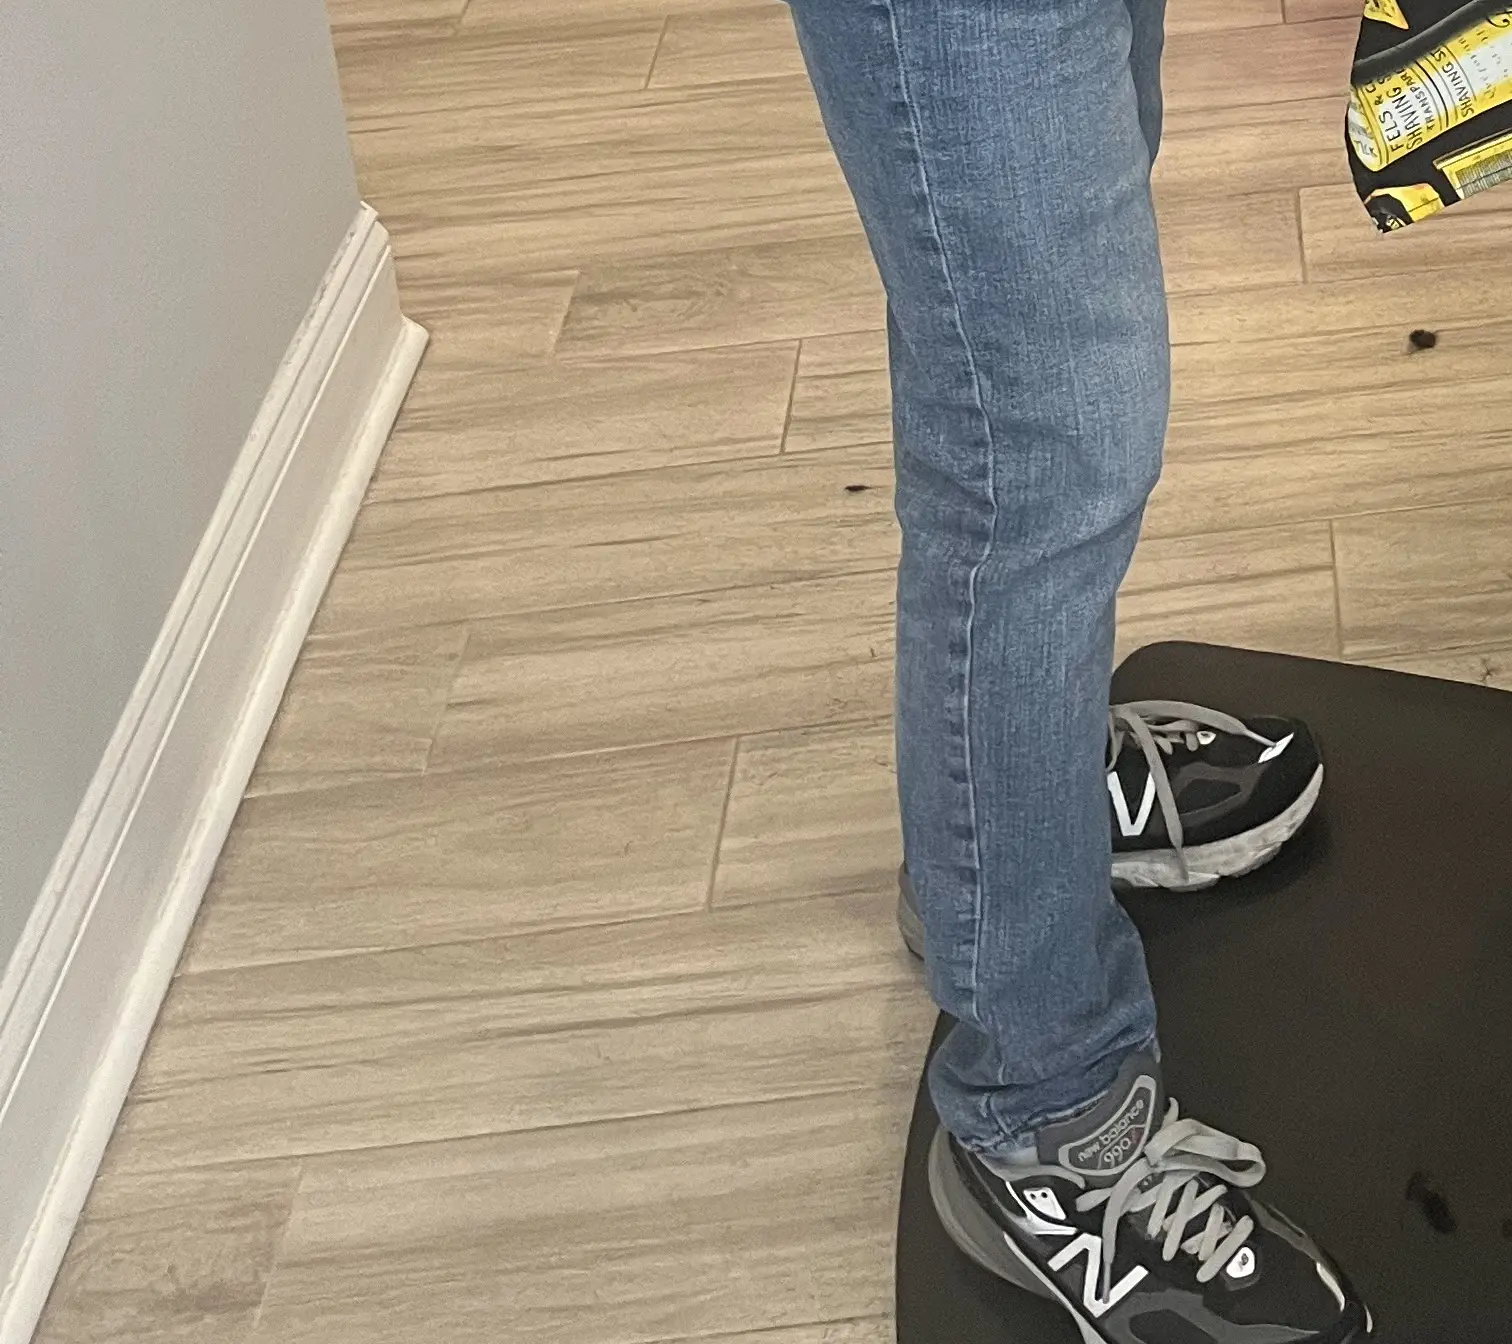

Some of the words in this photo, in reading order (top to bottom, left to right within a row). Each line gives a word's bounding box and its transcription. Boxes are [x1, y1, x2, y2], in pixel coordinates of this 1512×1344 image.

[1441, 65, 1475, 118] SHAVING
[1378, 110, 1405, 153] FELS
[1386, 85, 1424, 150] SHAVING
[1099, 1098, 1145, 1145] balance
[1103, 1136, 1132, 1171] 990
[1047, 1232, 1149, 1318] N
